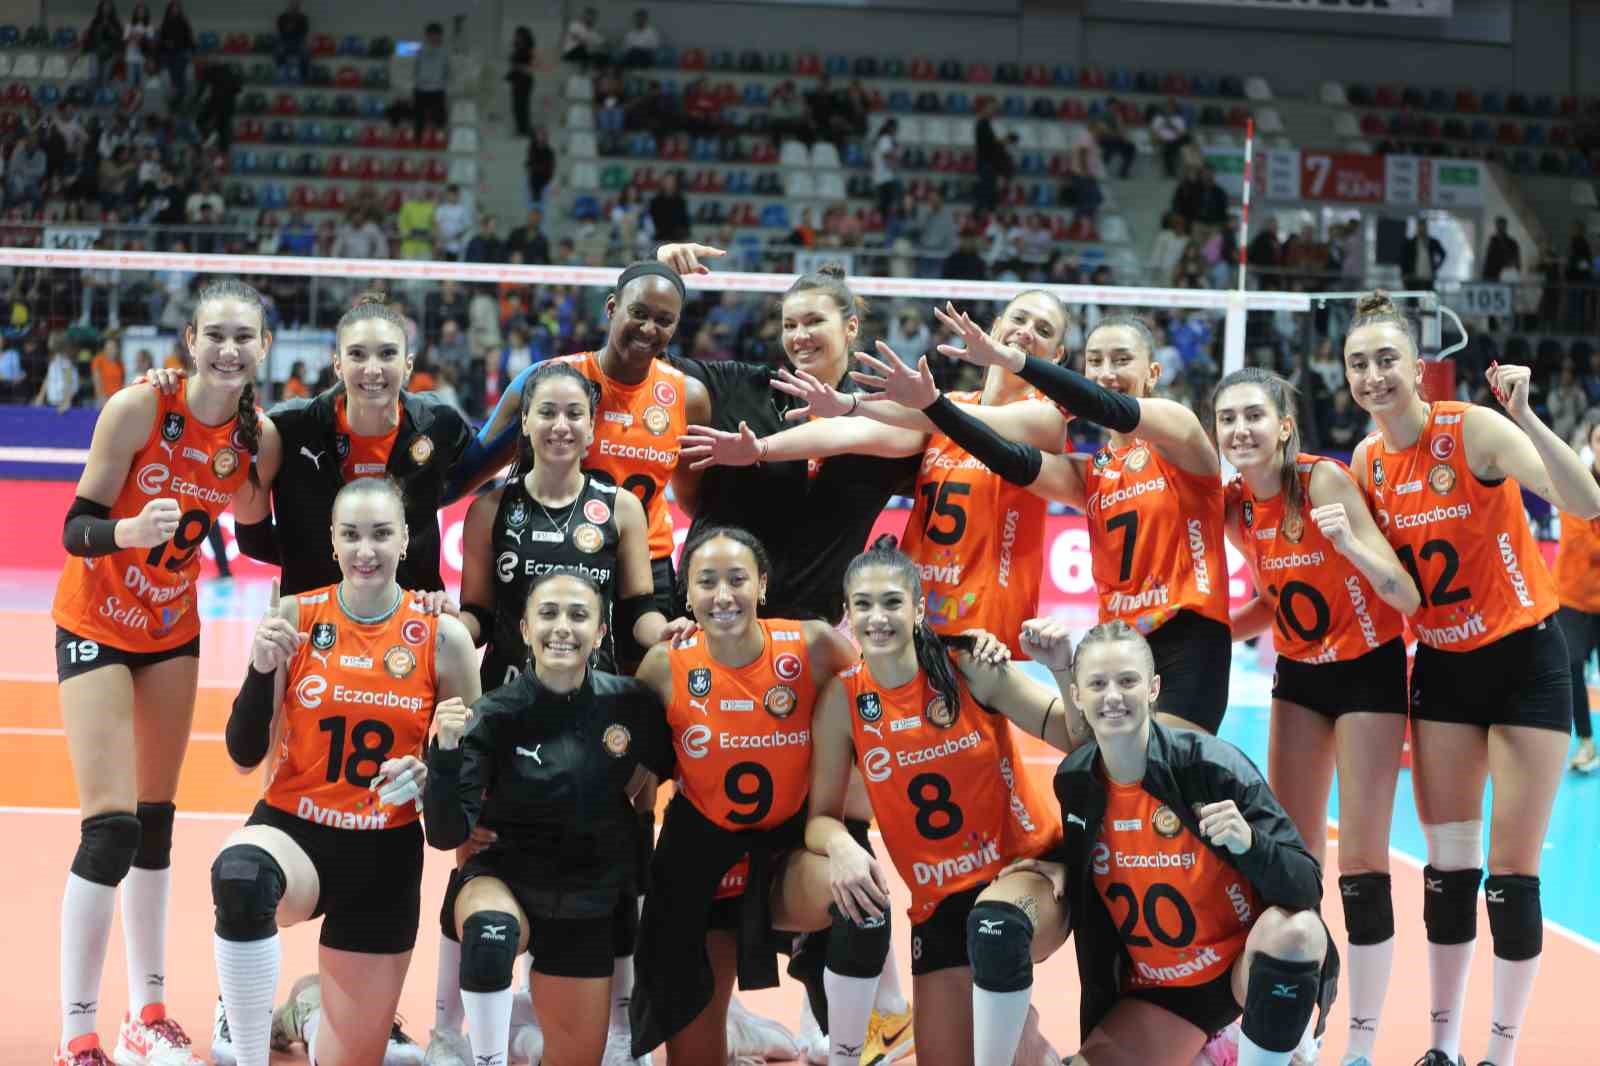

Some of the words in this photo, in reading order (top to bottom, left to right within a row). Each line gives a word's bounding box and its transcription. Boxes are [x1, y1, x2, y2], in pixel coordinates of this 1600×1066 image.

[1306, 156, 1331, 196] 7
[920, 481, 971, 545] 15
[1395, 504, 1472, 528] Eczacıbaşı
[998, 509, 1019, 587] PEGASUS
[1106, 510, 1140, 582] 7
[1187, 518, 1211, 595] PEGASUS
[912, 562, 964, 586] navit
[1497, 532, 1536, 608] PEGASUS
[99, 597, 149, 629] Selin
[1345, 576, 1380, 648] PEGASUS
[66, 640, 99, 664] 19
[333, 685, 423, 713] Eczacıbaşı
[319, 715, 394, 788] 18
[720, 729, 810, 749] Eczacıbaşı
[896, 730, 981, 767] Eczacıbaşı
[724, 761, 774, 825] 9
[907, 772, 963, 840] 8
[913, 839, 1000, 887] Dynavit
[1115, 851, 1196, 870] Eczacıbaşı
[1105, 883, 1197, 947] 20
[1226, 883, 1251, 925] ASUS
[913, 937, 922, 960] 8
[1138, 946, 1222, 982] Dynavit
